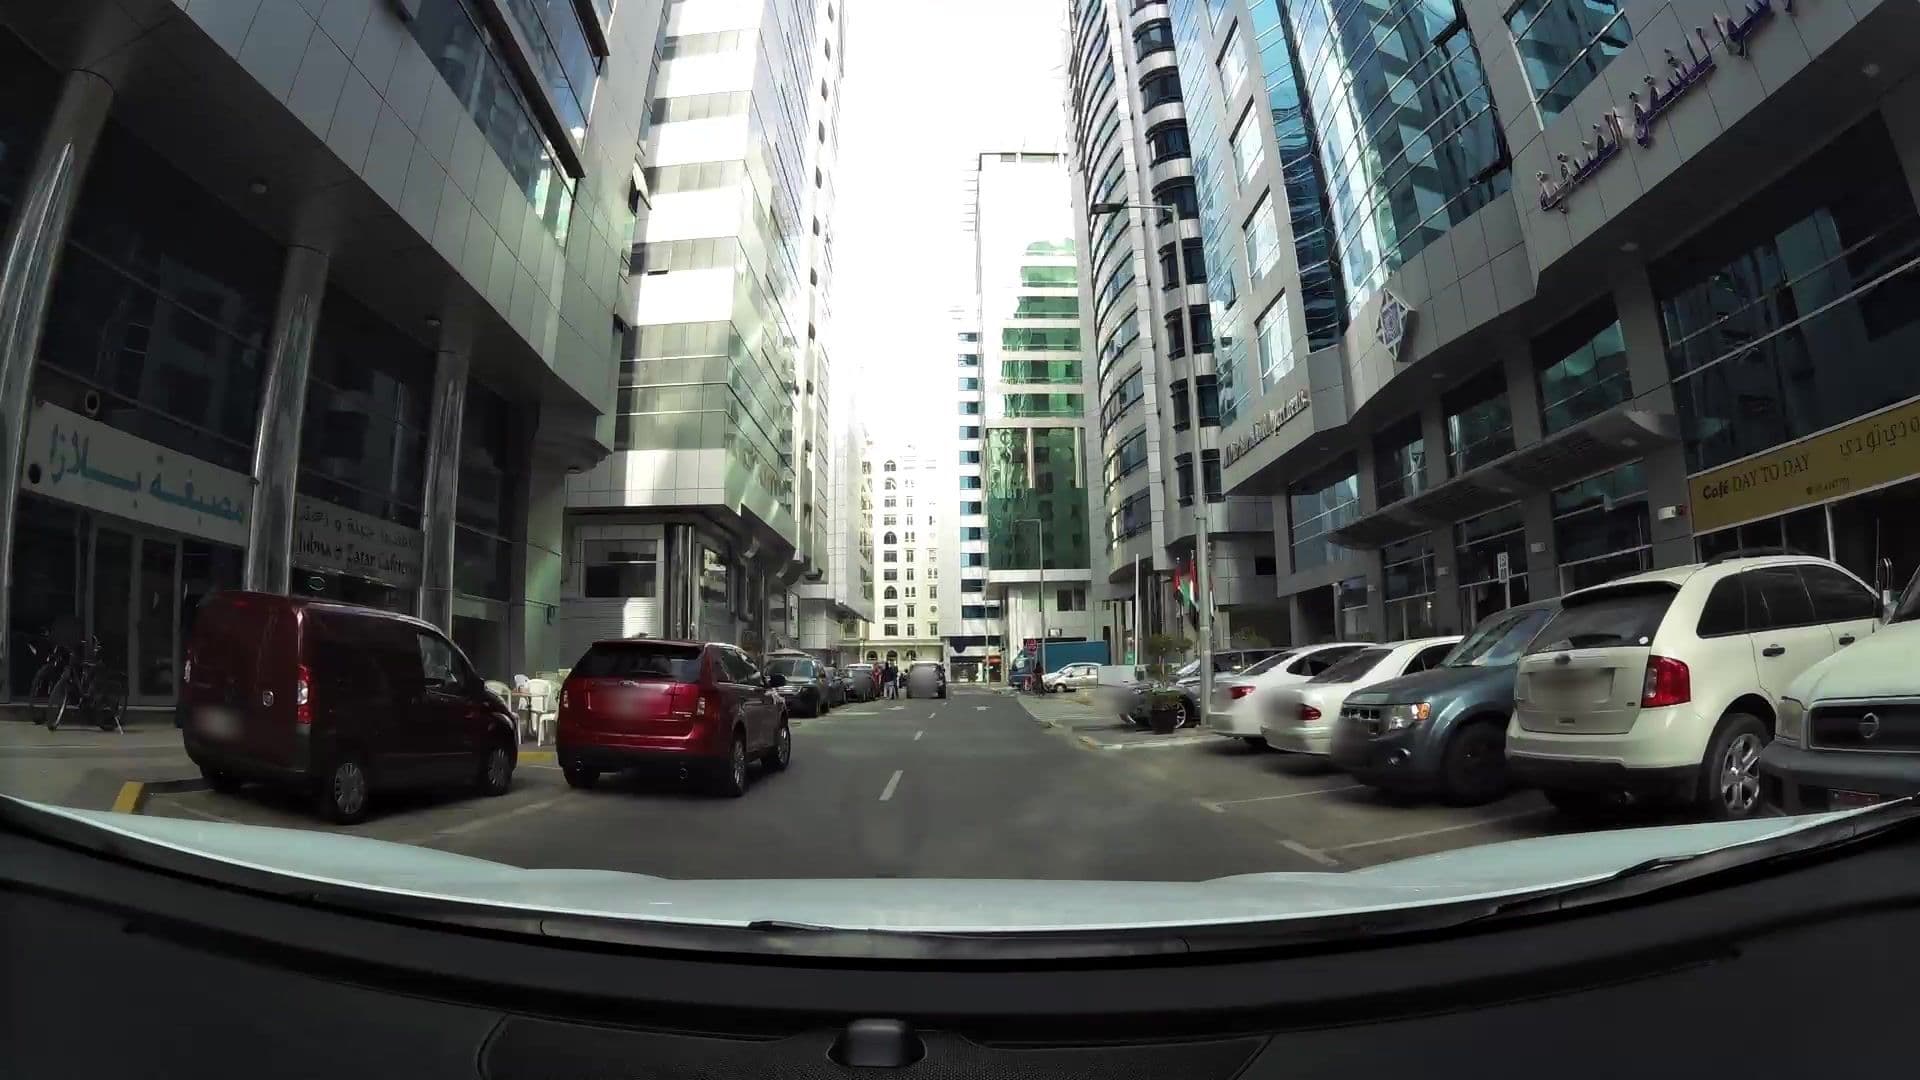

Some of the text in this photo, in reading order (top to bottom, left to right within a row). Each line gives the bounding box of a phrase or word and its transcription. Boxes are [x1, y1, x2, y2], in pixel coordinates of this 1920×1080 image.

[1703, 453, 1811, 500] Café DAY TO DAY
